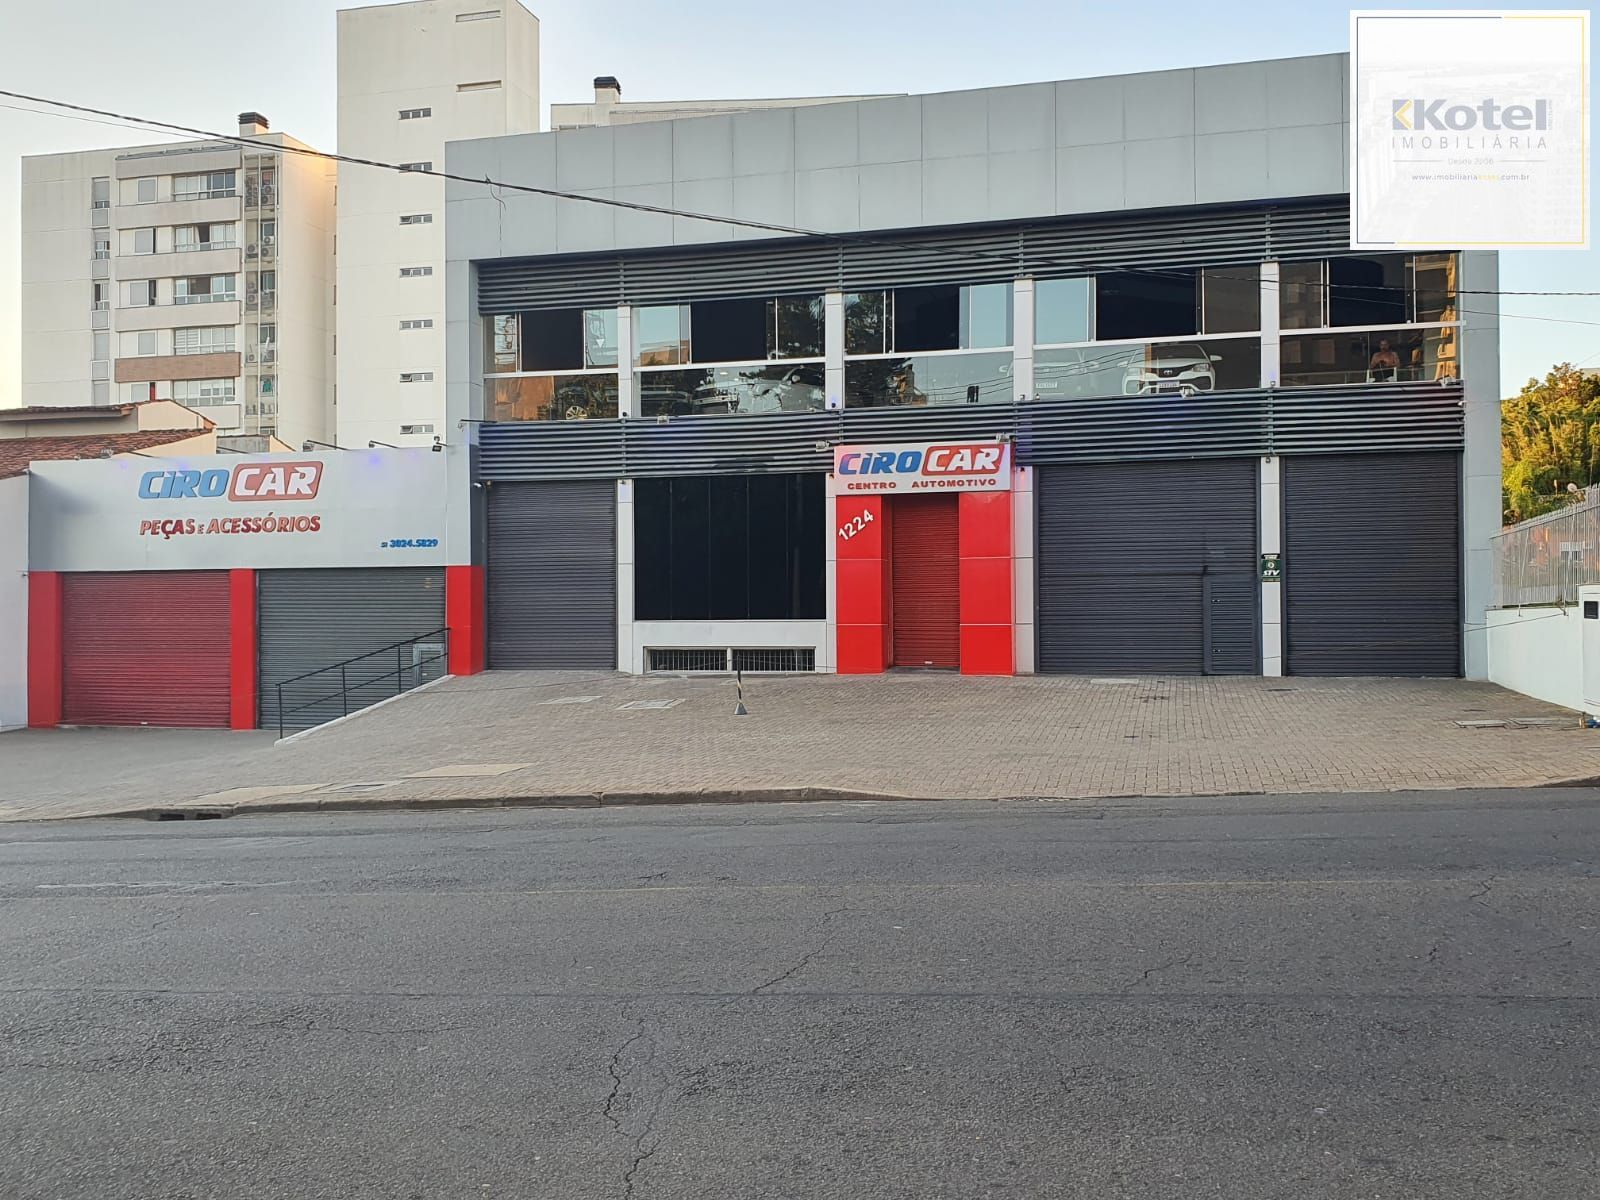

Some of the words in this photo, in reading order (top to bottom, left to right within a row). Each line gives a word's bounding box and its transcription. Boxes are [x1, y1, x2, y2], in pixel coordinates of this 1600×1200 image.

[847, 481, 897, 490] CENTRO
[911, 478, 997, 489] AUTOMOTIVO
[139, 518, 196, 540] PEÇAS
[206, 511, 321, 535] ACESSÓRIOS
[838, 509, 874, 540] 1224
